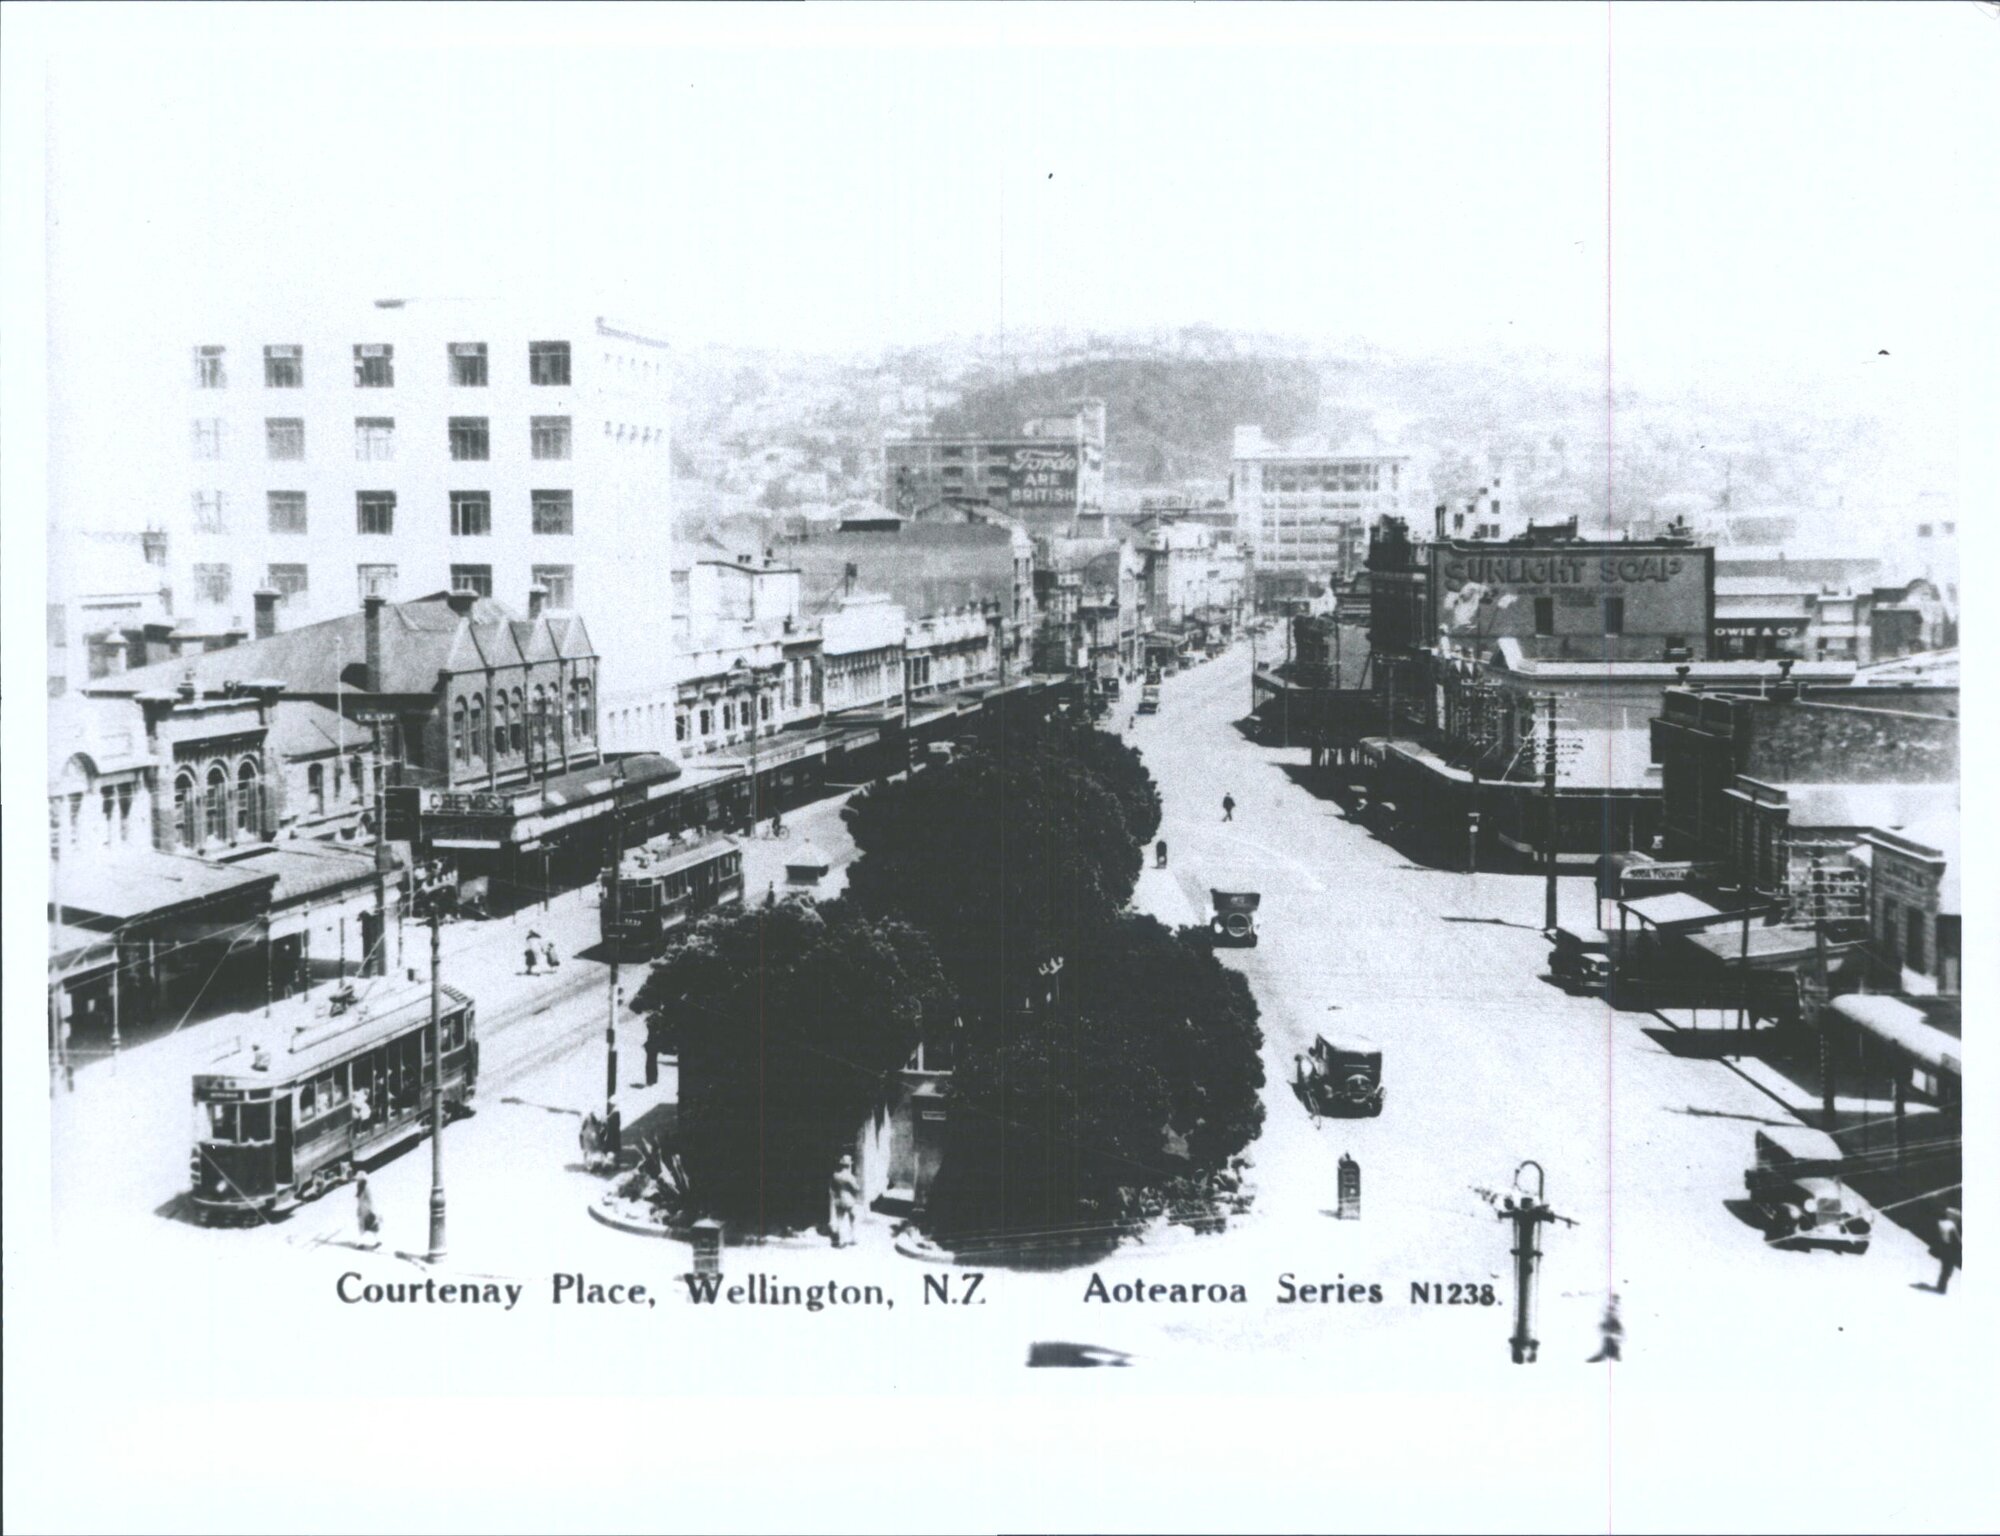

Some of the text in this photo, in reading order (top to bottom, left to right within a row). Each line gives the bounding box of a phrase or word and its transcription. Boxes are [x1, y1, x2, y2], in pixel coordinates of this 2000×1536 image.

[1024, 473, 1060, 486] ARE
[1012, 488, 1075, 501] BRITISH
[1444, 557, 1682, 592] SUNLIGHT SOAP
